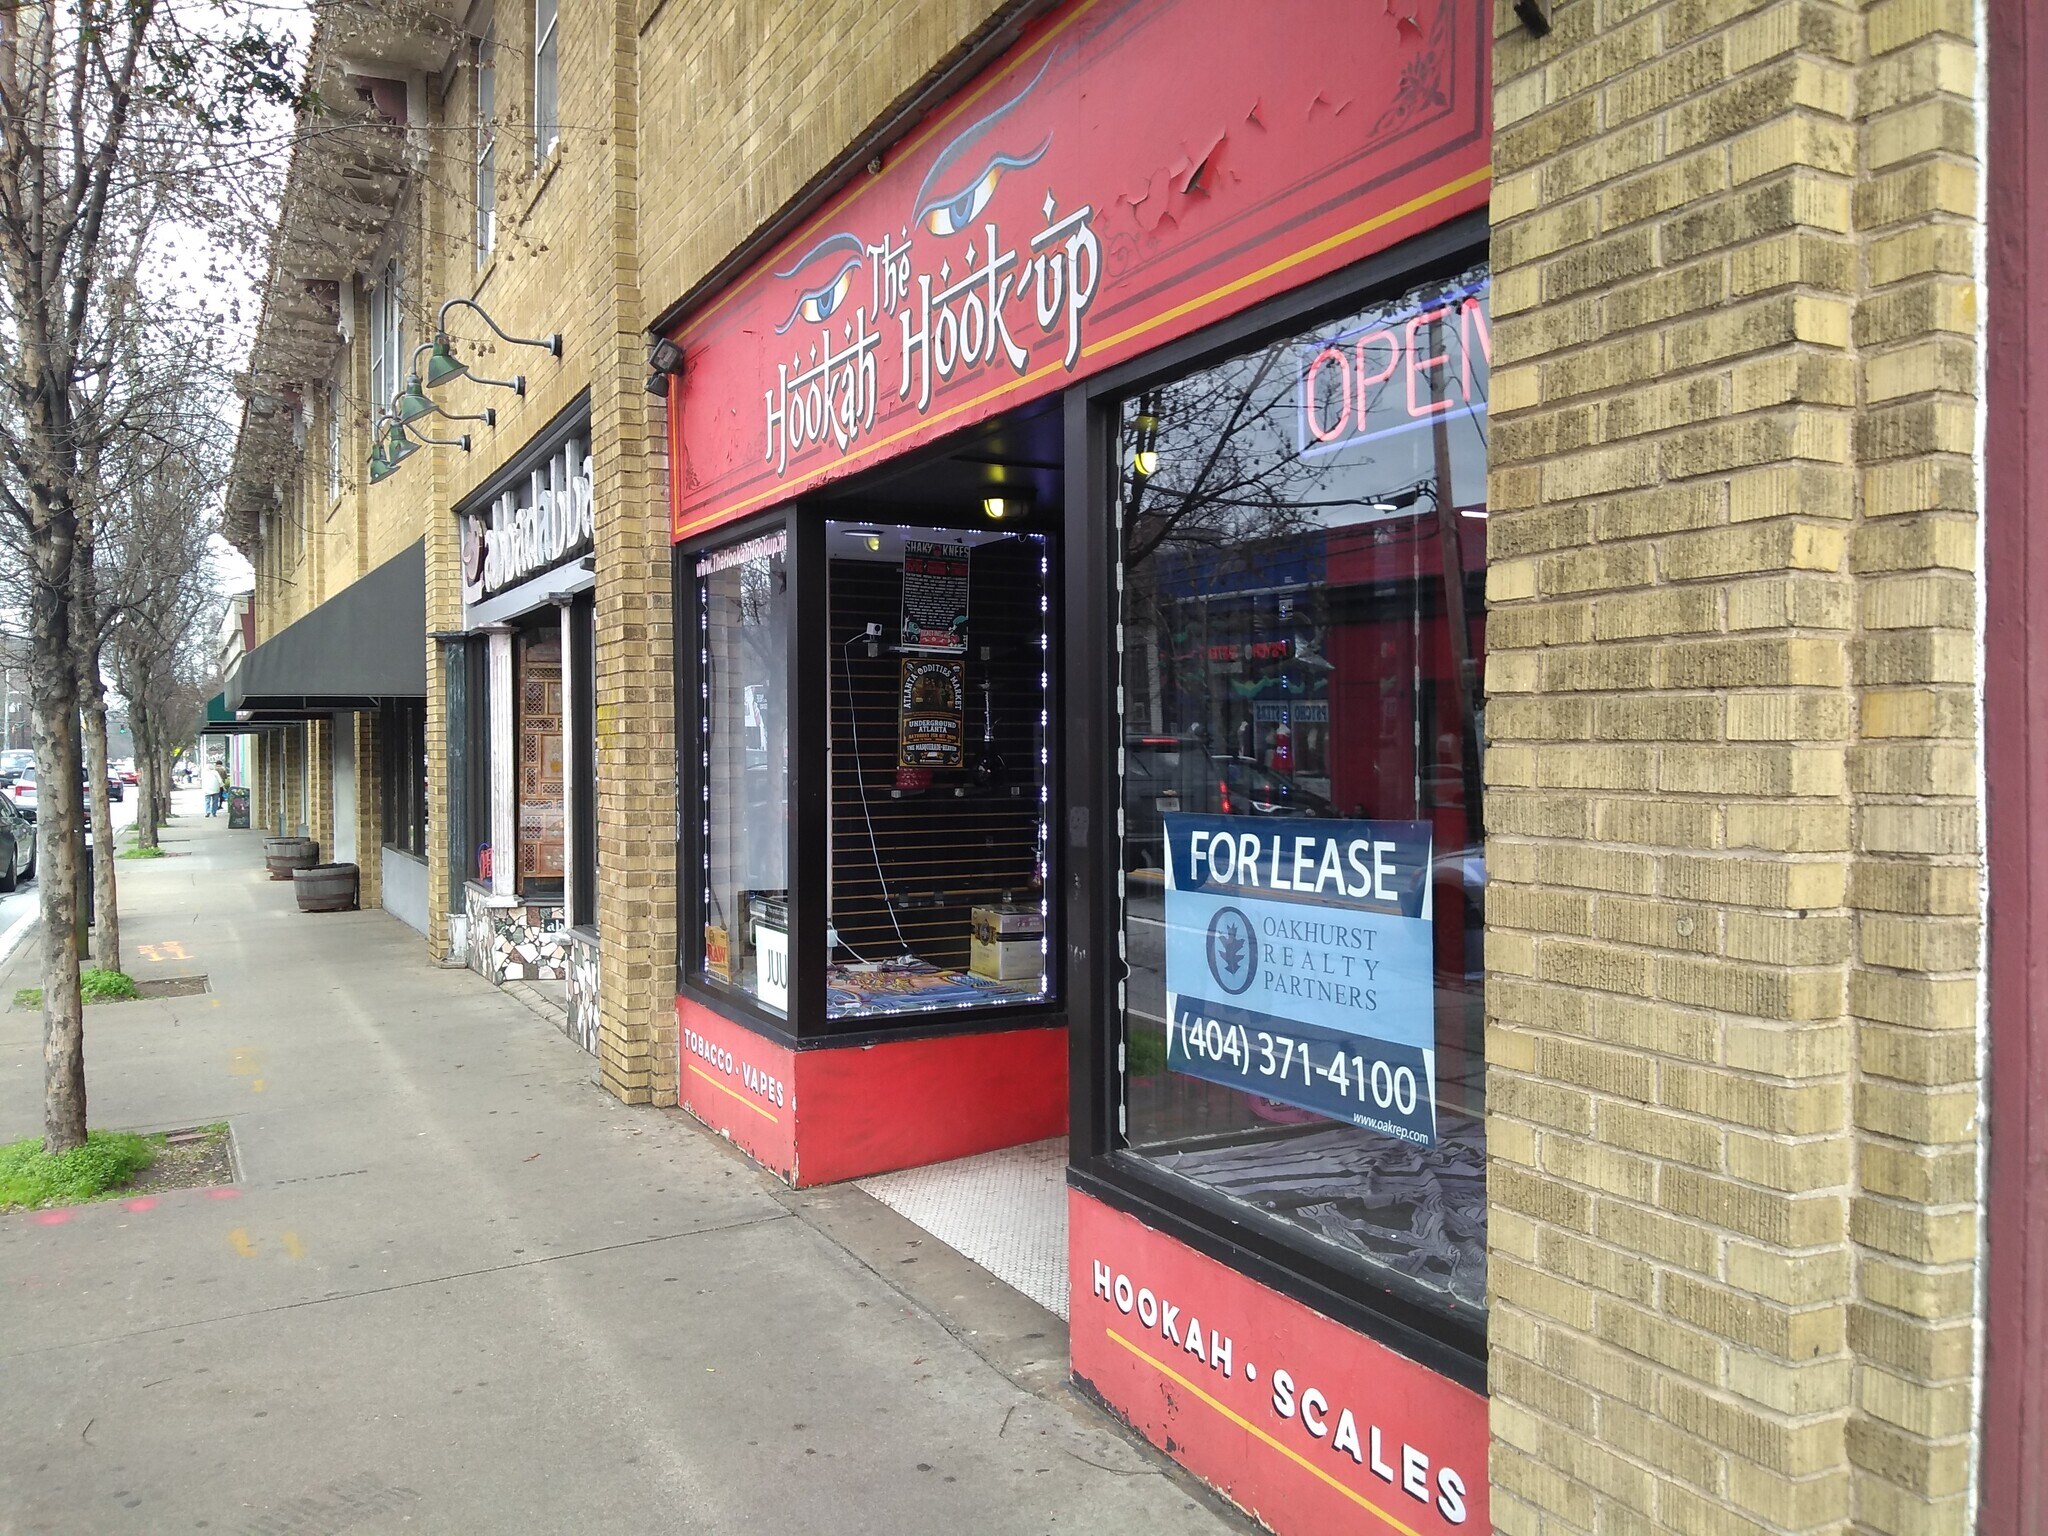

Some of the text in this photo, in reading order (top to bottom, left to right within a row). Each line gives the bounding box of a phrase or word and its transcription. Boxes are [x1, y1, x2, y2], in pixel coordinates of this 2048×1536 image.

[866, 222, 912, 322] The
[764, 308, 881, 477] Hookah
[905, 540, 969, 558] SHAKY KNEES
[903, 663, 962, 710] ATLANTA ODDITIES MARKET
[908, 720, 957, 729] UNDERGROUND
[1190, 831, 1398, 901] FOR LEASE
[706, 943, 726, 963] RAW
[1263, 916, 1378, 951] OAKHURST
[1264, 943, 1380, 981] REALTY
[1264, 970, 1377, 1011] PARTNERS
[684, 1027, 784, 1108] TOBACCO VAPES
[1181, 1011, 1416, 1115] (404) 371-4100
[1353, 1112, 1429, 1146] www.oakrep.com
[1093, 1259, 1467, 1525] HOOKAH SCALES
